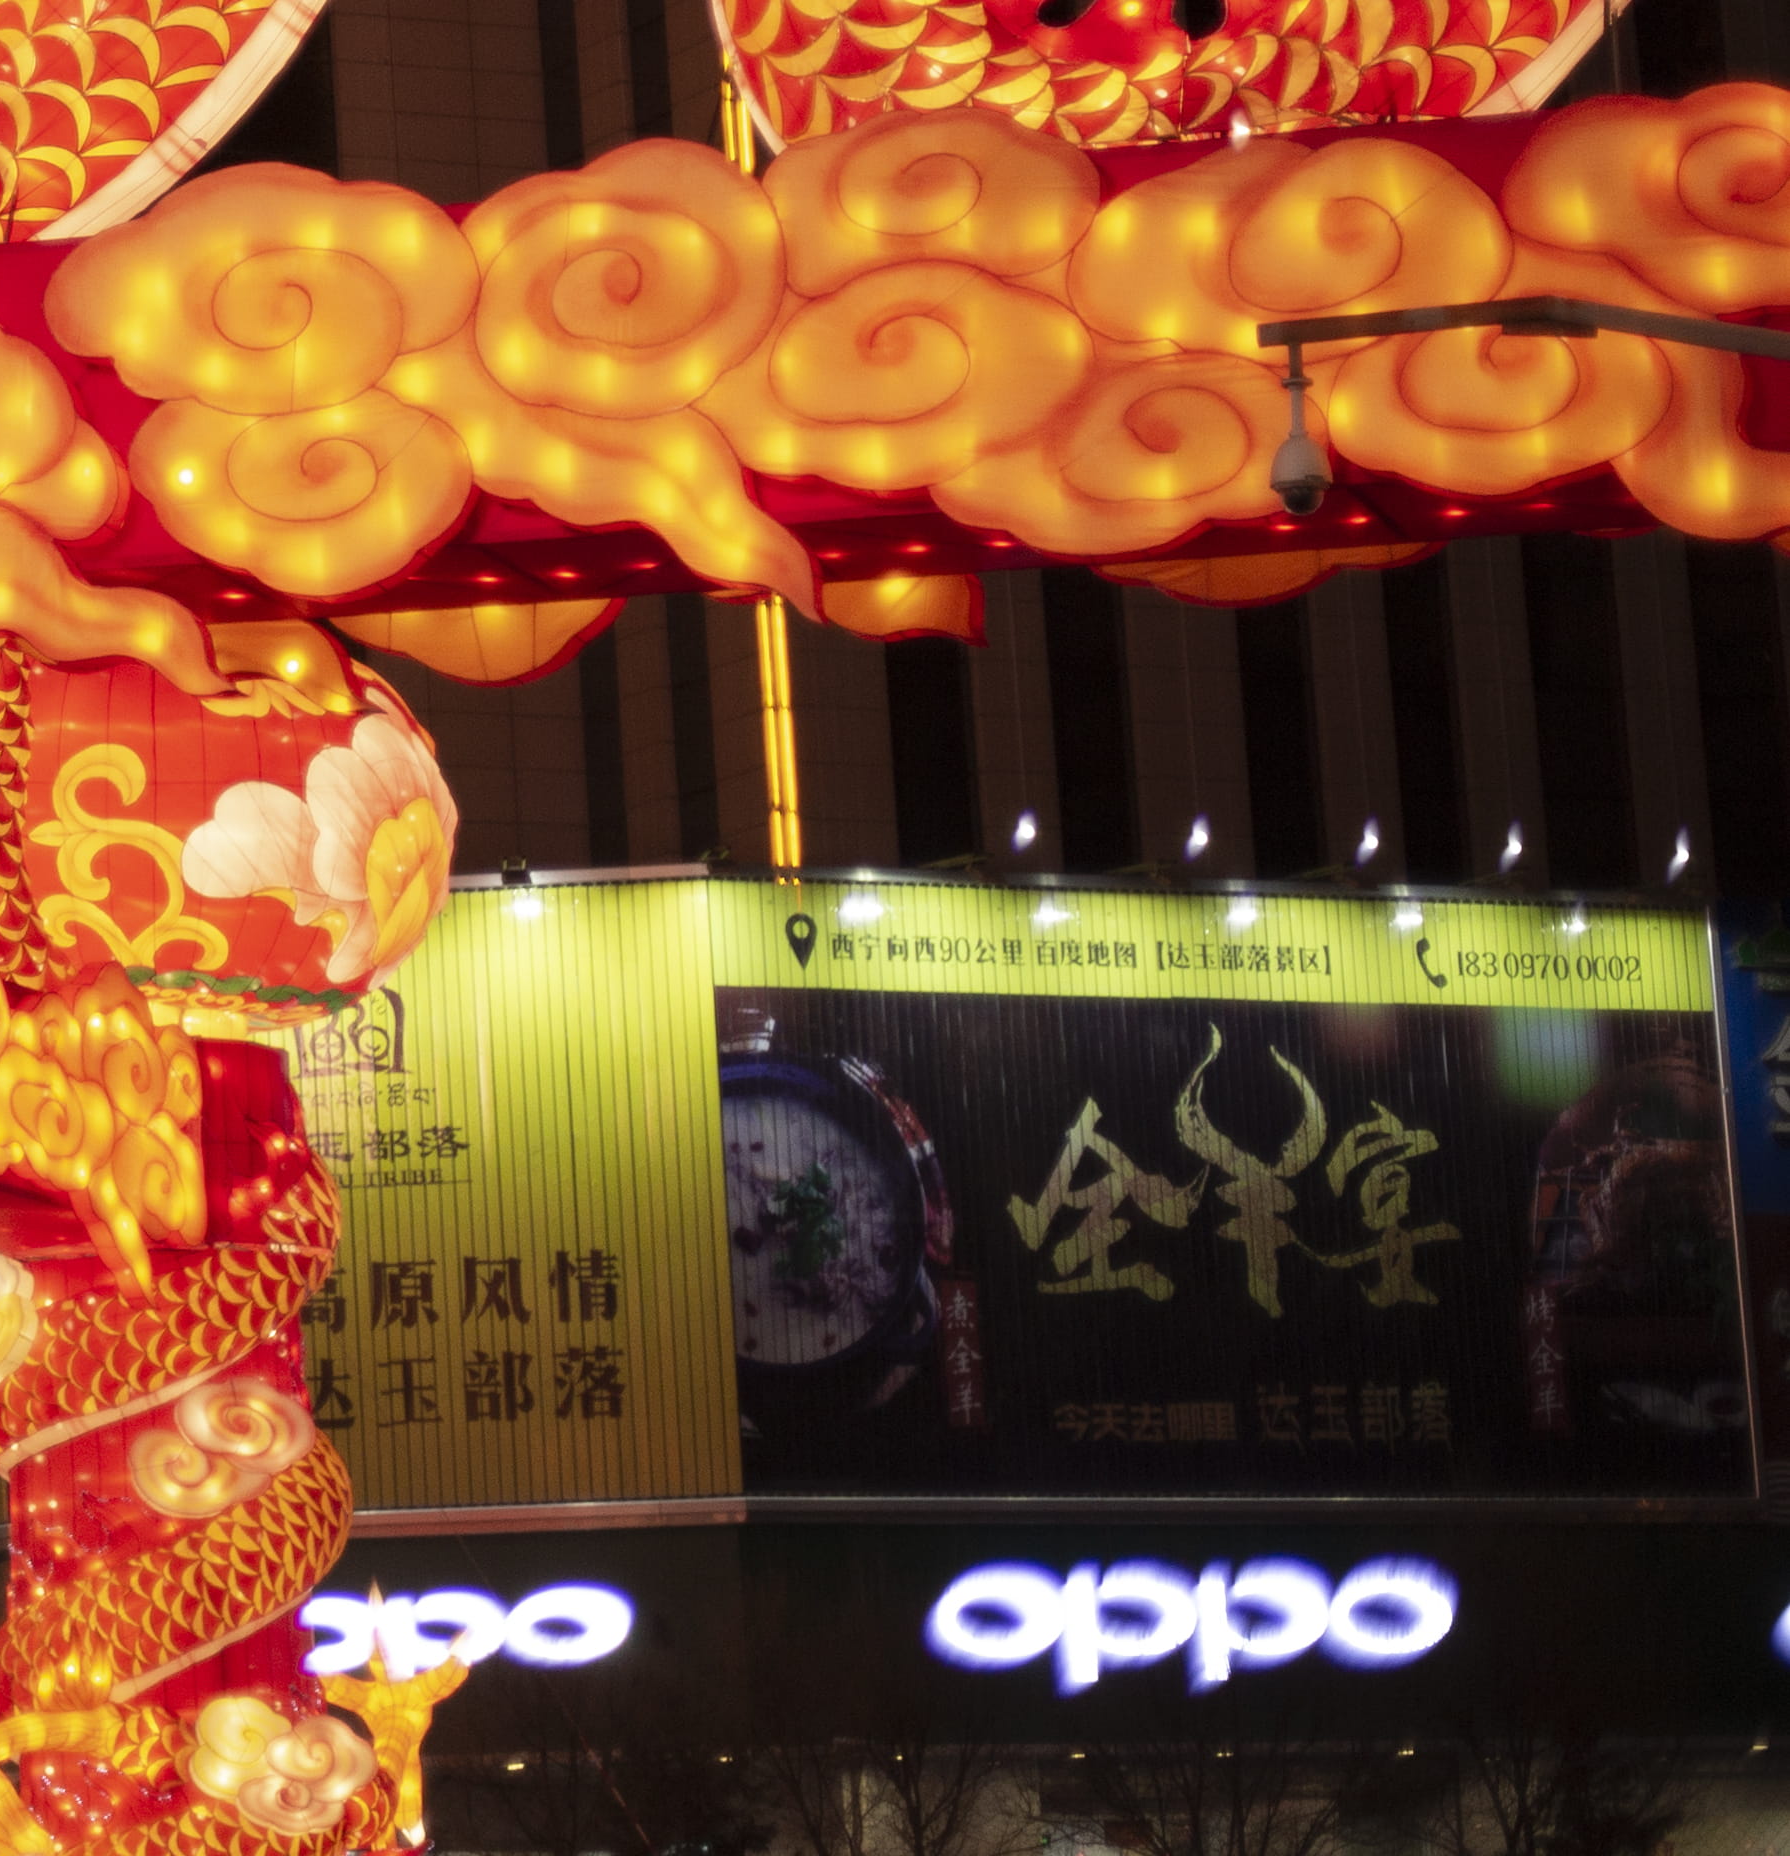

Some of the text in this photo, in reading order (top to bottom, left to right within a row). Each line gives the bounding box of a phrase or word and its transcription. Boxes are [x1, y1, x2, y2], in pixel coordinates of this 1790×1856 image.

[832, 933, 1025, 966] 西宁向西90公里
[1036, 940, 1138, 970] 百度地图
[301, 1250, 620, 1334] 高原风情
[311, 1346, 625, 1430] 达玉部落
[1053, 1379, 1453, 1455] 今天去哪里 达玉部落
